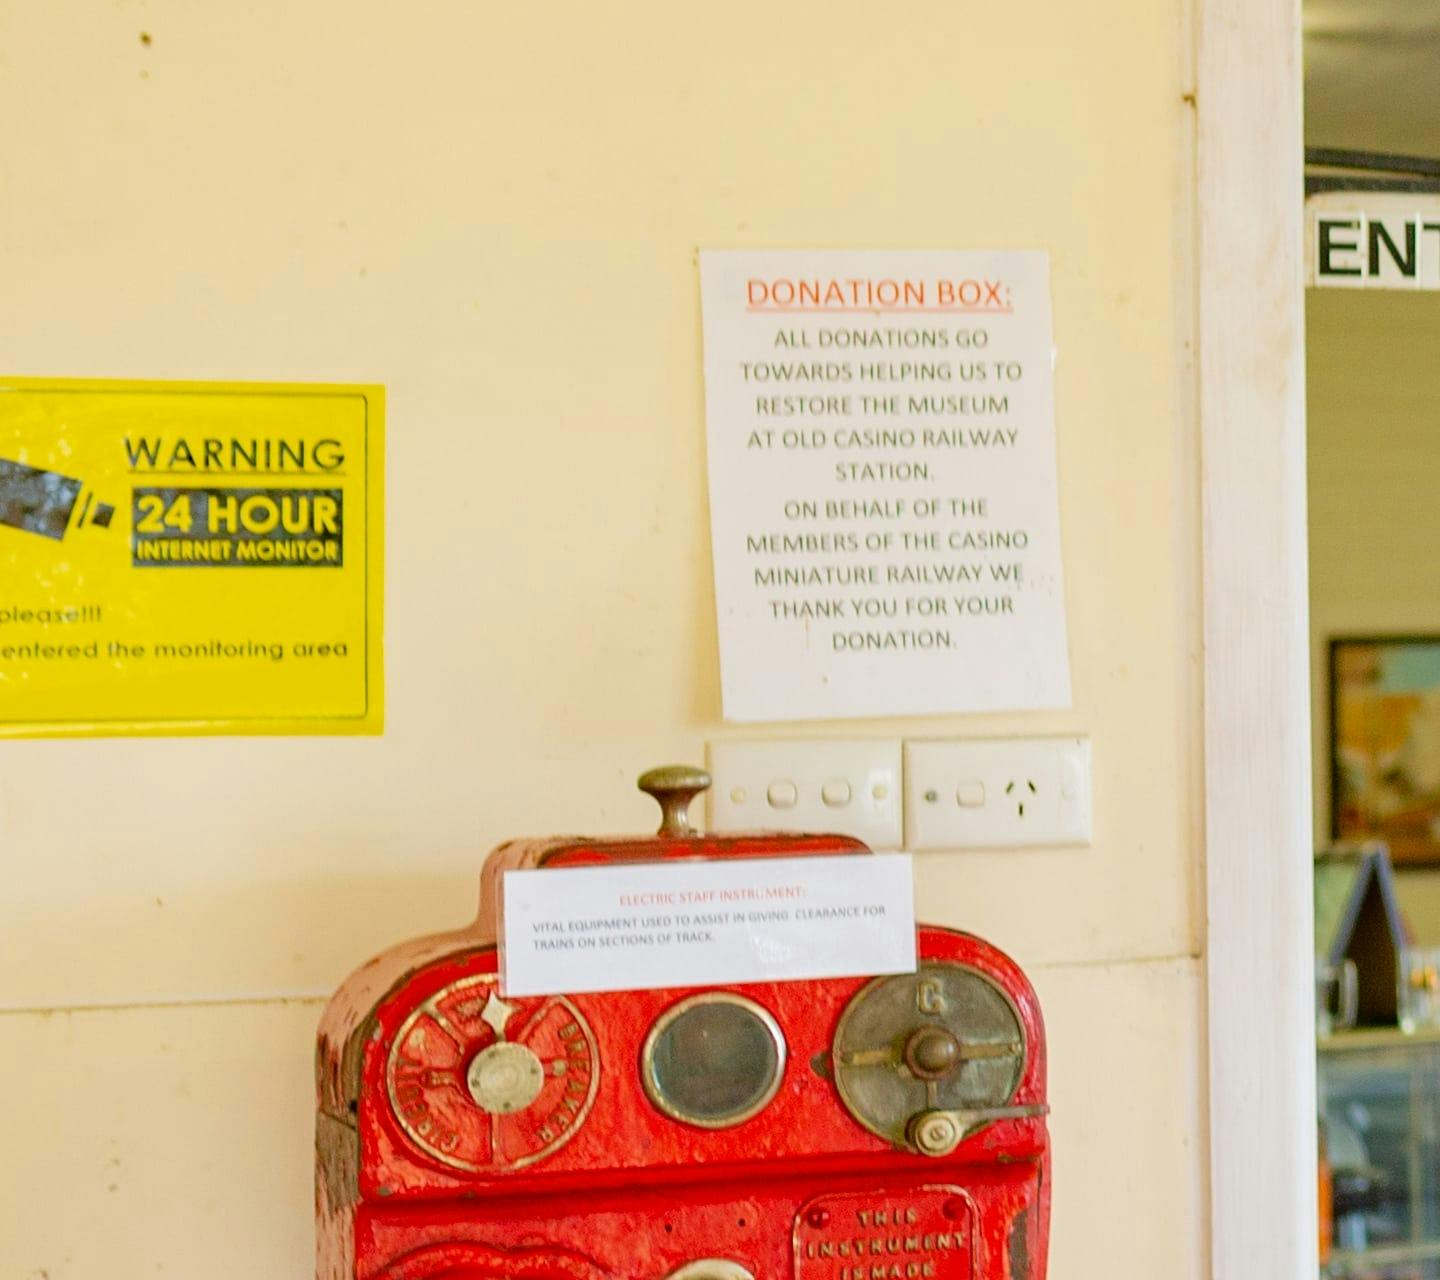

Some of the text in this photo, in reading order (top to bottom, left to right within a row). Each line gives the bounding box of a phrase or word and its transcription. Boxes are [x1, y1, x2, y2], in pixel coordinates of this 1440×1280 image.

[745, 279, 1013, 307] DONATION BOX:
[774, 329, 989, 349] ALL DONATIONS GO
[739, 362, 1023, 382] TOWARDS HELPING US TO
[756, 396, 1010, 416] RESTORE THE MUSEUM
[747, 428, 1019, 450] AT OLD CASINO RAILWAY
[124, 437, 346, 471] WARNING
[835, 463, 936, 482] STATION.
[136, 494, 339, 535] 24 HOUR
[783, 498, 989, 520] ON BEHALF OF THE
[136, 538, 339, 561] INTERNET MONITOR
[746, 530, 1030, 553] MEMBERS OF THE CASINO
[753, 563, 1025, 587] MINIATURE RAILWAY WE
[768, 596, 1015, 620] THANK YOU FOR YOUR
[1, 638, 348, 663] entered the monitoring area
[832, 630, 959, 651] DONATION.
[619, 891, 677, 907] ELECTRIC
[680, 889, 716, 904] STAFF
[532, 904, 887, 934] VITAL EQUIPMENT USED TO ASSIST IN GIVING CLEARANCE FOR
[533, 930, 715, 951] TRAINS ON SECTIONS OF TRACK.
[858, 1208, 918, 1227] THIS
[805, 1231, 966, 1259] INSTRUMENT
[870, 1261, 935, 1280] MADE
